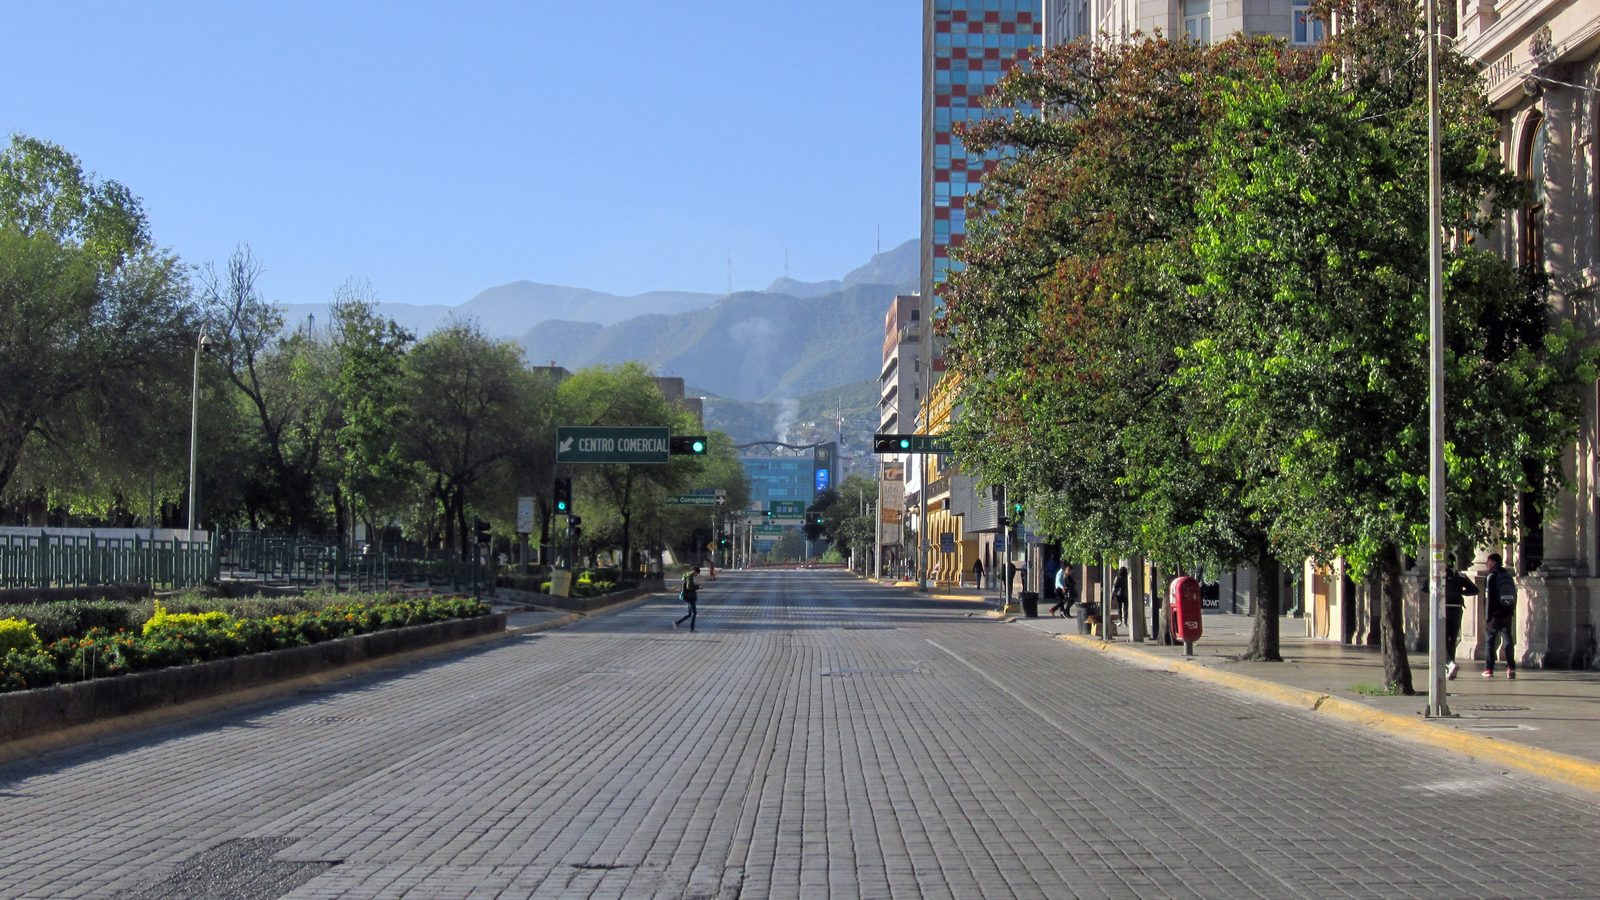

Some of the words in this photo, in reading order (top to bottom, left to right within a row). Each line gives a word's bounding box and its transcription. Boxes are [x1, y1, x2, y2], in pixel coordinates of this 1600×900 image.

[578, 438, 615, 452] CENTRO
[617, 438, 668, 453] COMERCIAL
[917, 438, 927, 450] J.
[680, 496, 715, 505] Corregidora
